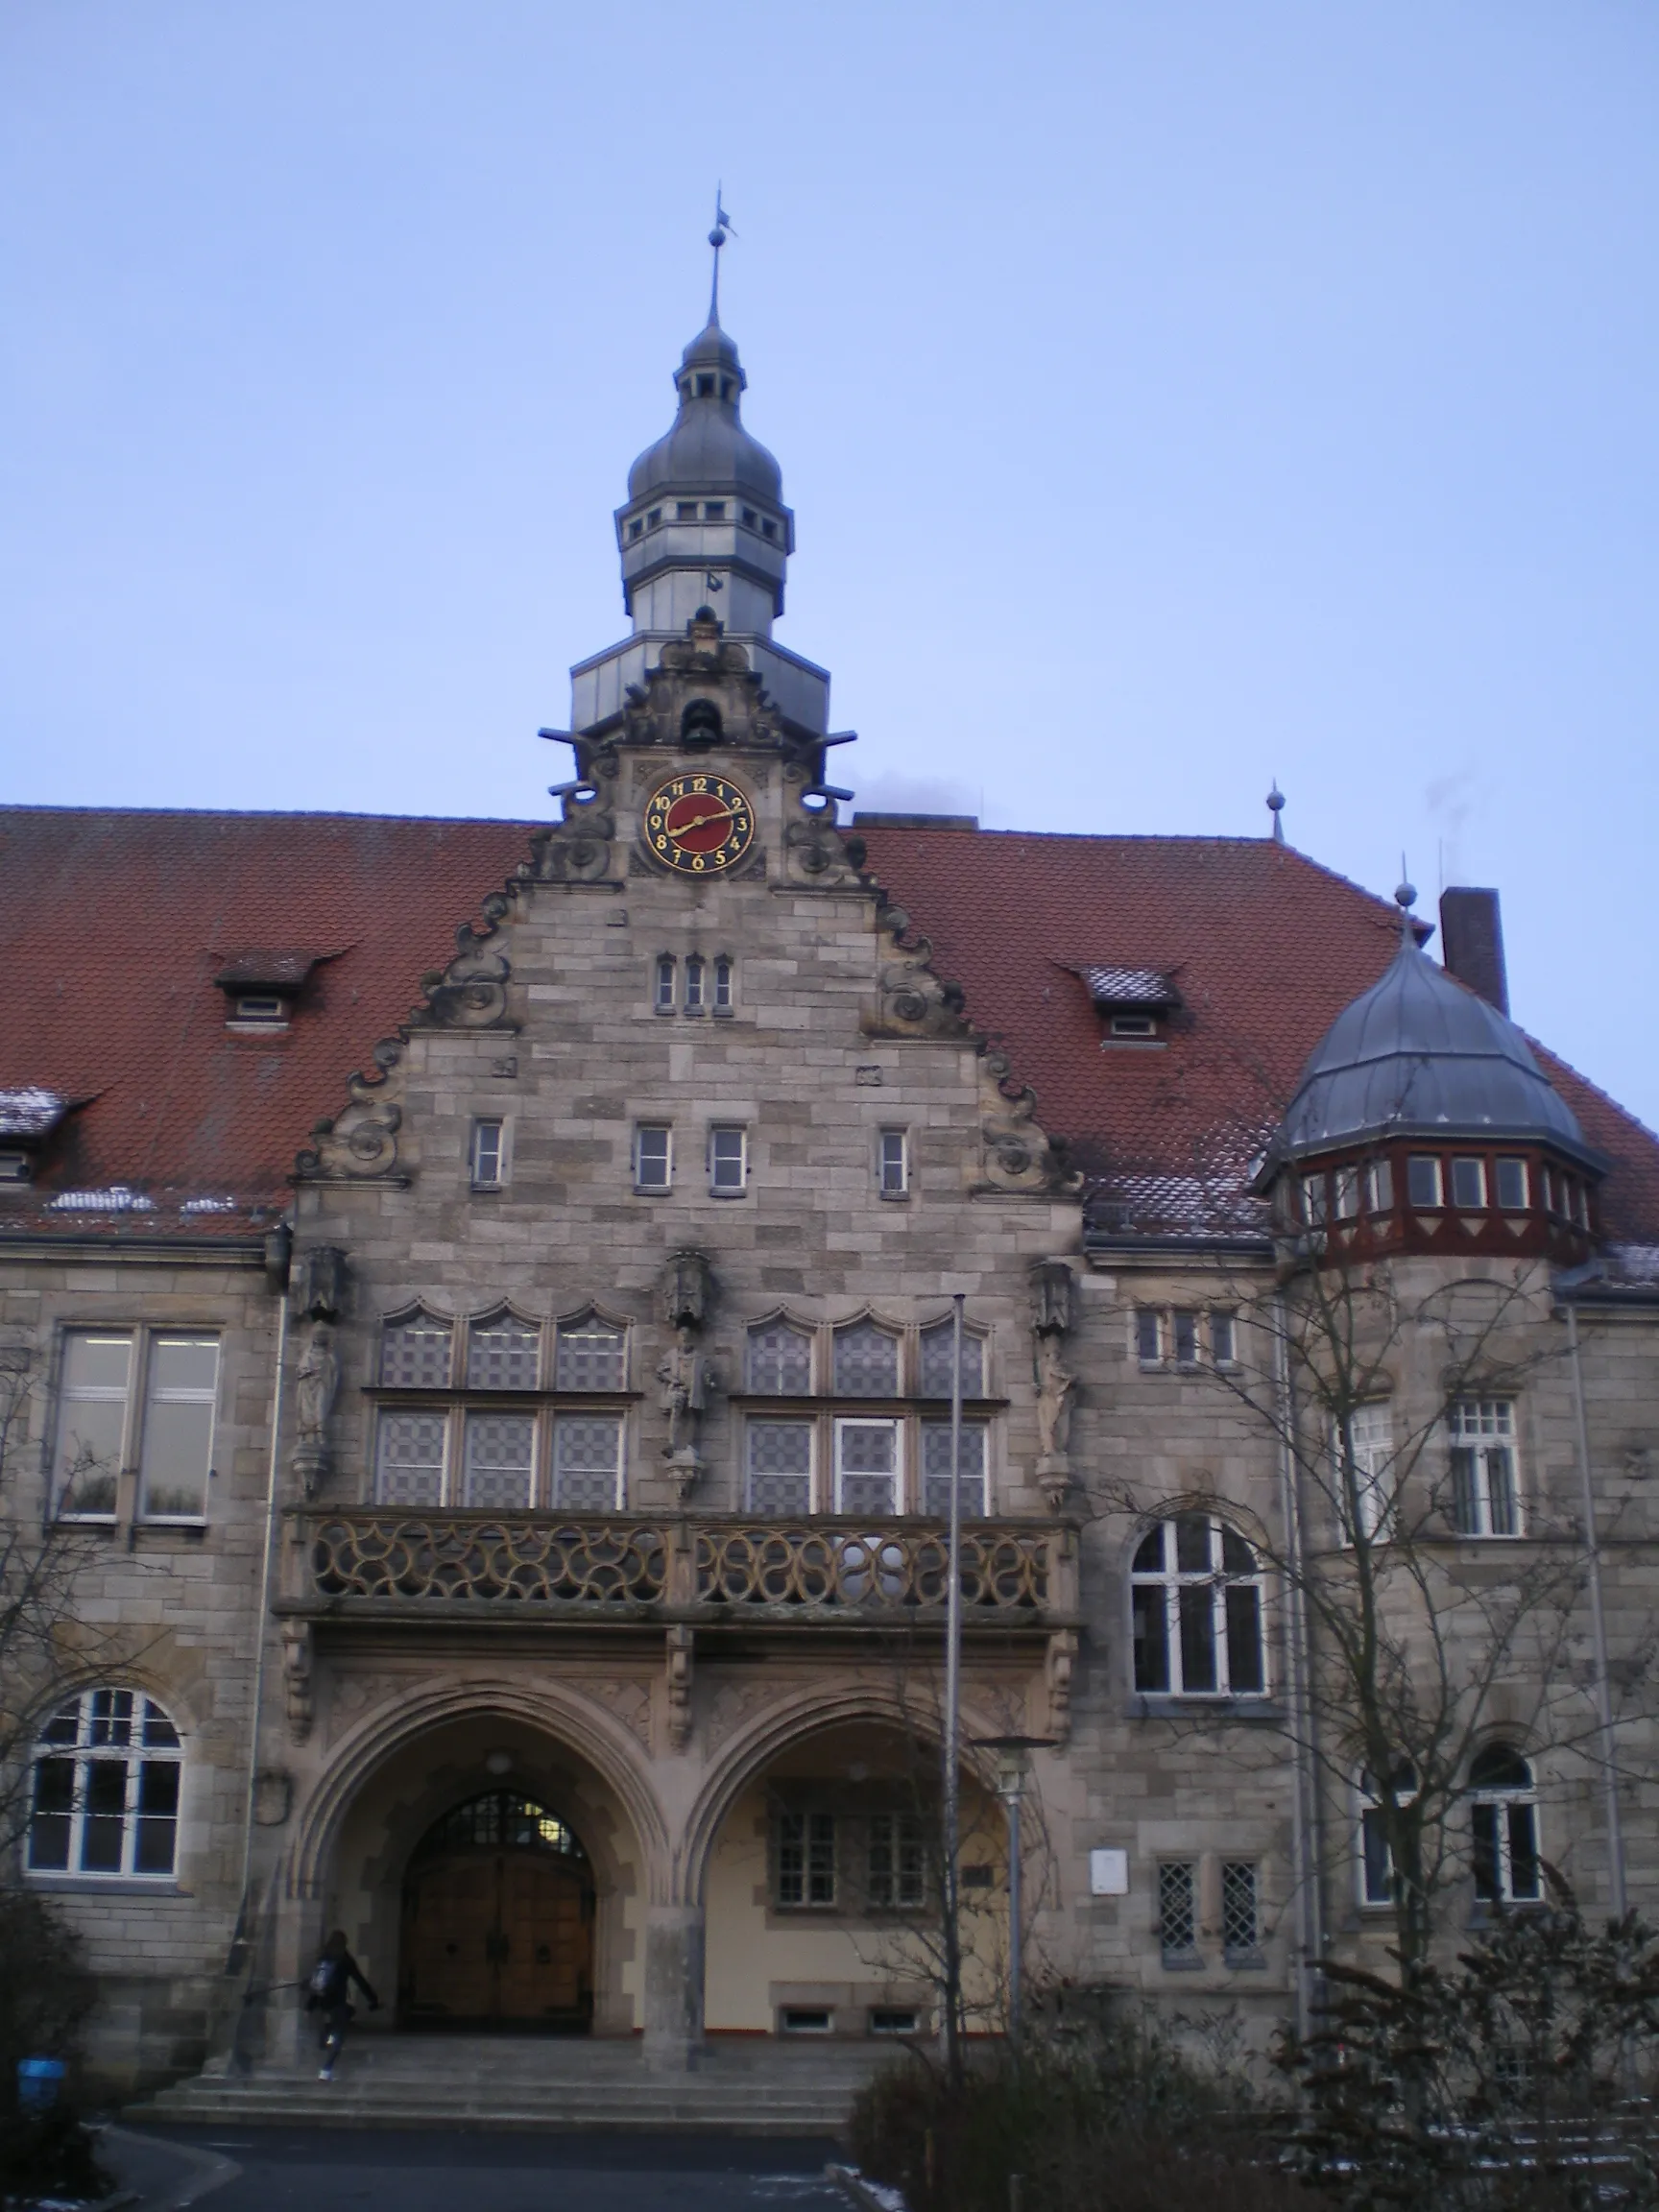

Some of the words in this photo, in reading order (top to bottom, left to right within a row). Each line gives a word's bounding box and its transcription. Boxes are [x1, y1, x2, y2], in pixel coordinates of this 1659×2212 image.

[671, 782, 684, 795] 11
[692, 778, 707, 791] 12
[716, 783, 724, 797] 1
[655, 796, 670, 810] 10
[732, 797, 742, 810] 2
[650, 815, 662, 830] 9
[736, 817, 747, 831] 3
[656, 834, 667, 850] 8
[730, 836, 740, 851] 4
[672, 849, 682, 864] 7
[692, 854, 705, 870] 6
[714, 850, 726, 864] 5
